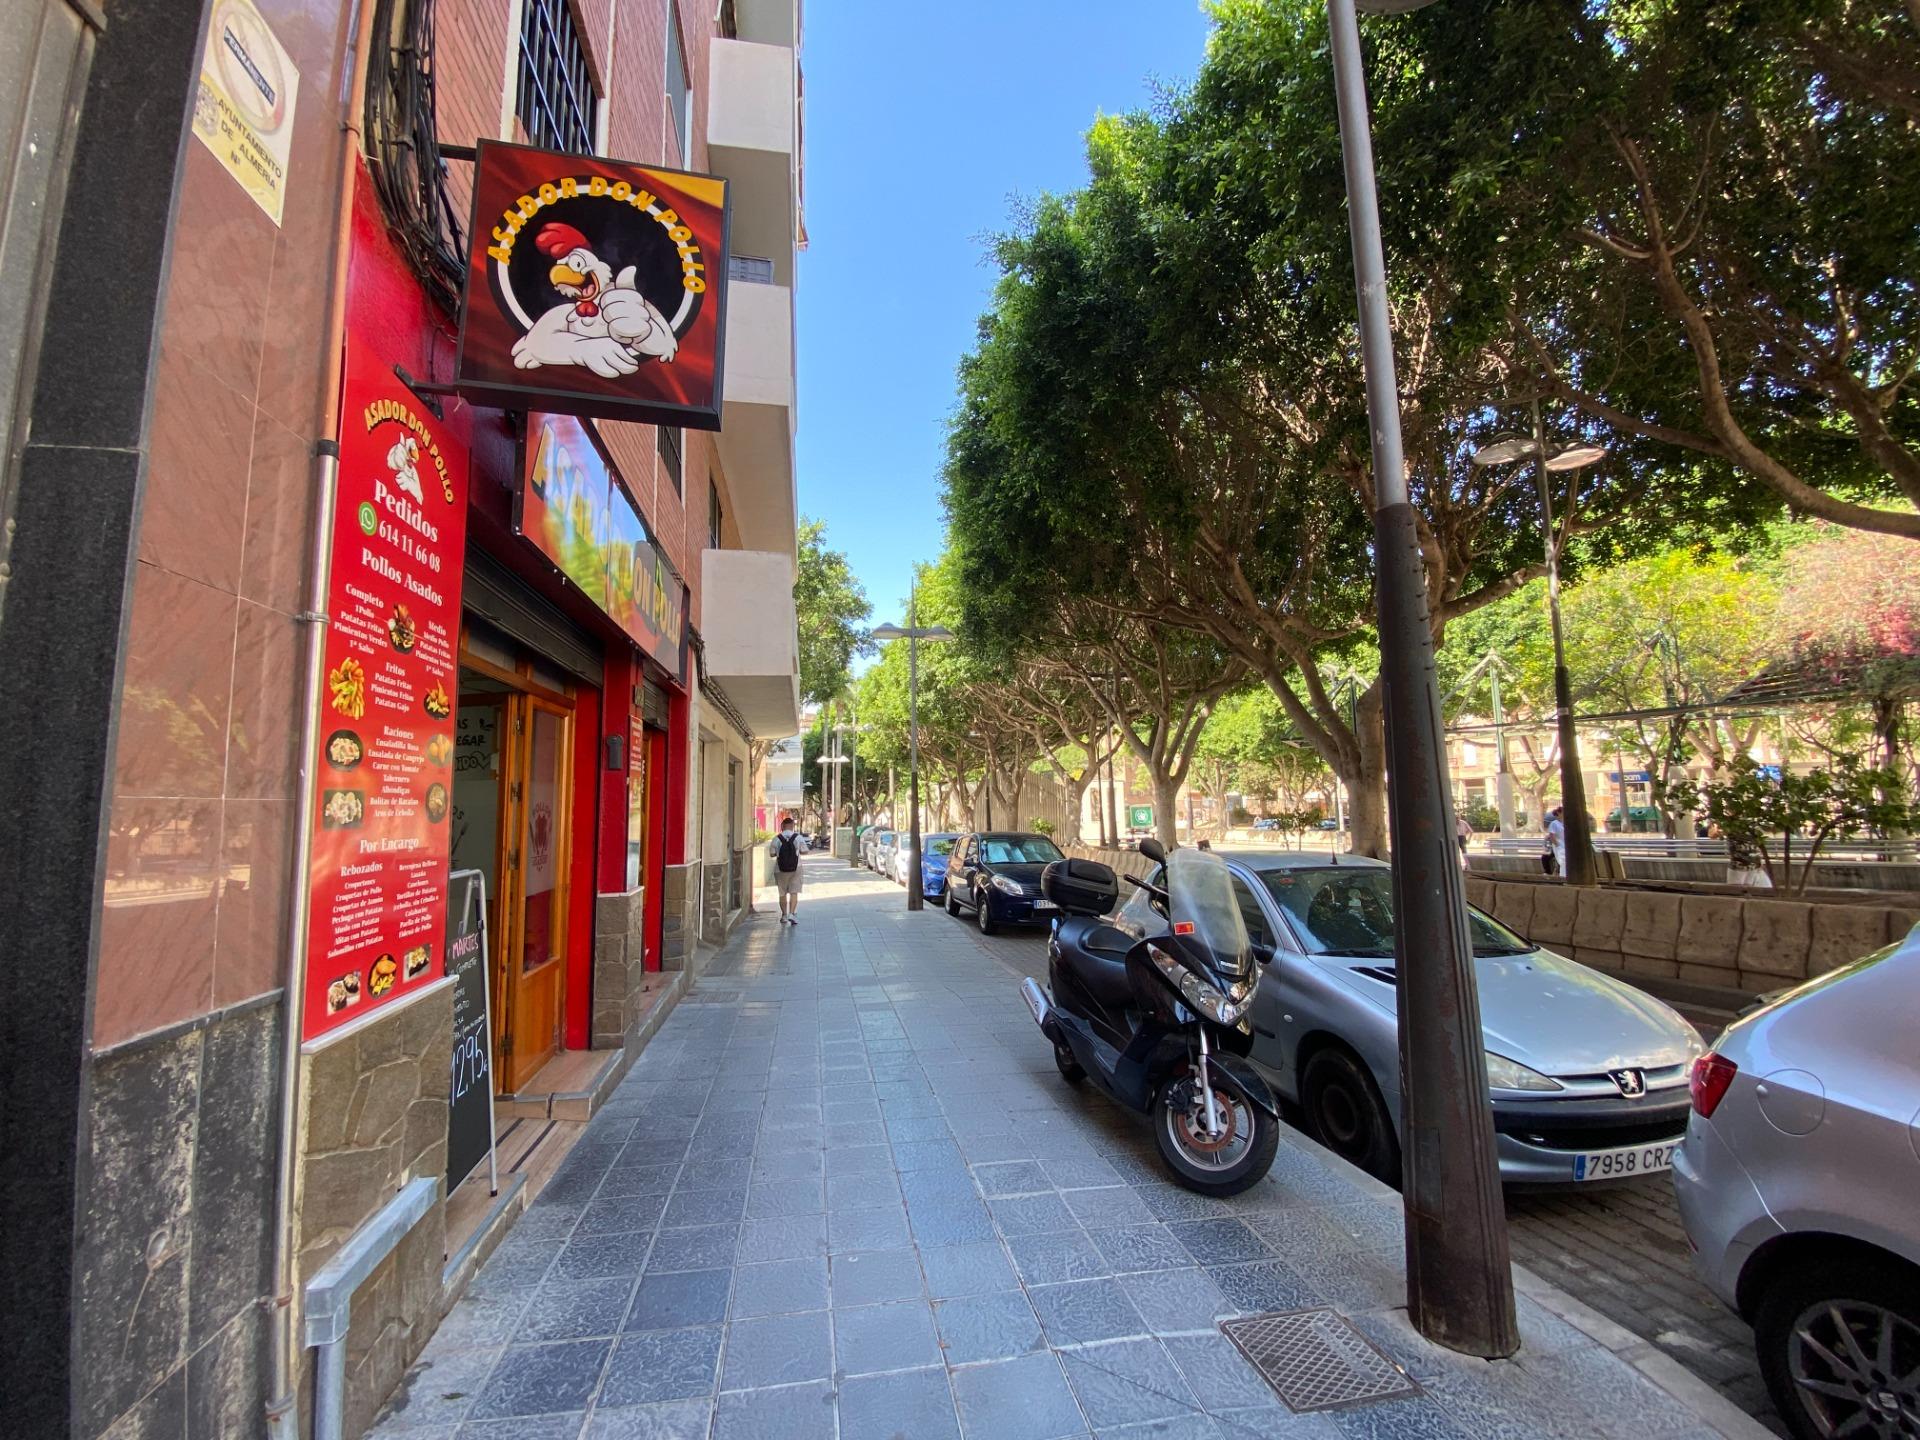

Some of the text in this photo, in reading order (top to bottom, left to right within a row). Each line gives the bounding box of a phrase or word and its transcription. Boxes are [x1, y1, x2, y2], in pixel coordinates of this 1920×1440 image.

[218, 98, 282, 179] AYUNTAMIENTO
[221, 119, 234, 142] DE
[487, 176, 707, 294] ASADOR DON POLLO
[364, 399, 454, 502] ASADOR DON POLLO
[374, 479, 438, 542] Pedidos
[379, 520, 441, 573] 614 11 66 08
[361, 547, 443, 606] Pollos Asados
[345, 583, 384, 609] Completo
[341, 611, 385, 635] Patatas Fritas
[428, 620, 447, 636] Medio
[334, 621, 388, 648] Pimientos Verdes
[374, 672, 396, 686] Patatas
[385, 662, 406, 677] Fritos
[371, 684, 398, 698] Pimientos
[374, 696, 397, 709] Patatas
[384, 725, 414, 740] Raciones
[375, 738, 406, 750] Ensaladilla
[368, 748, 394, 760] Ensalada
[360, 838, 419, 854] Por Encargo
[340, 861, 384, 877] Rebozados
[360, 899, 367, 908] de
[1589, 1146, 1674, 1176] 7958 CRZ
